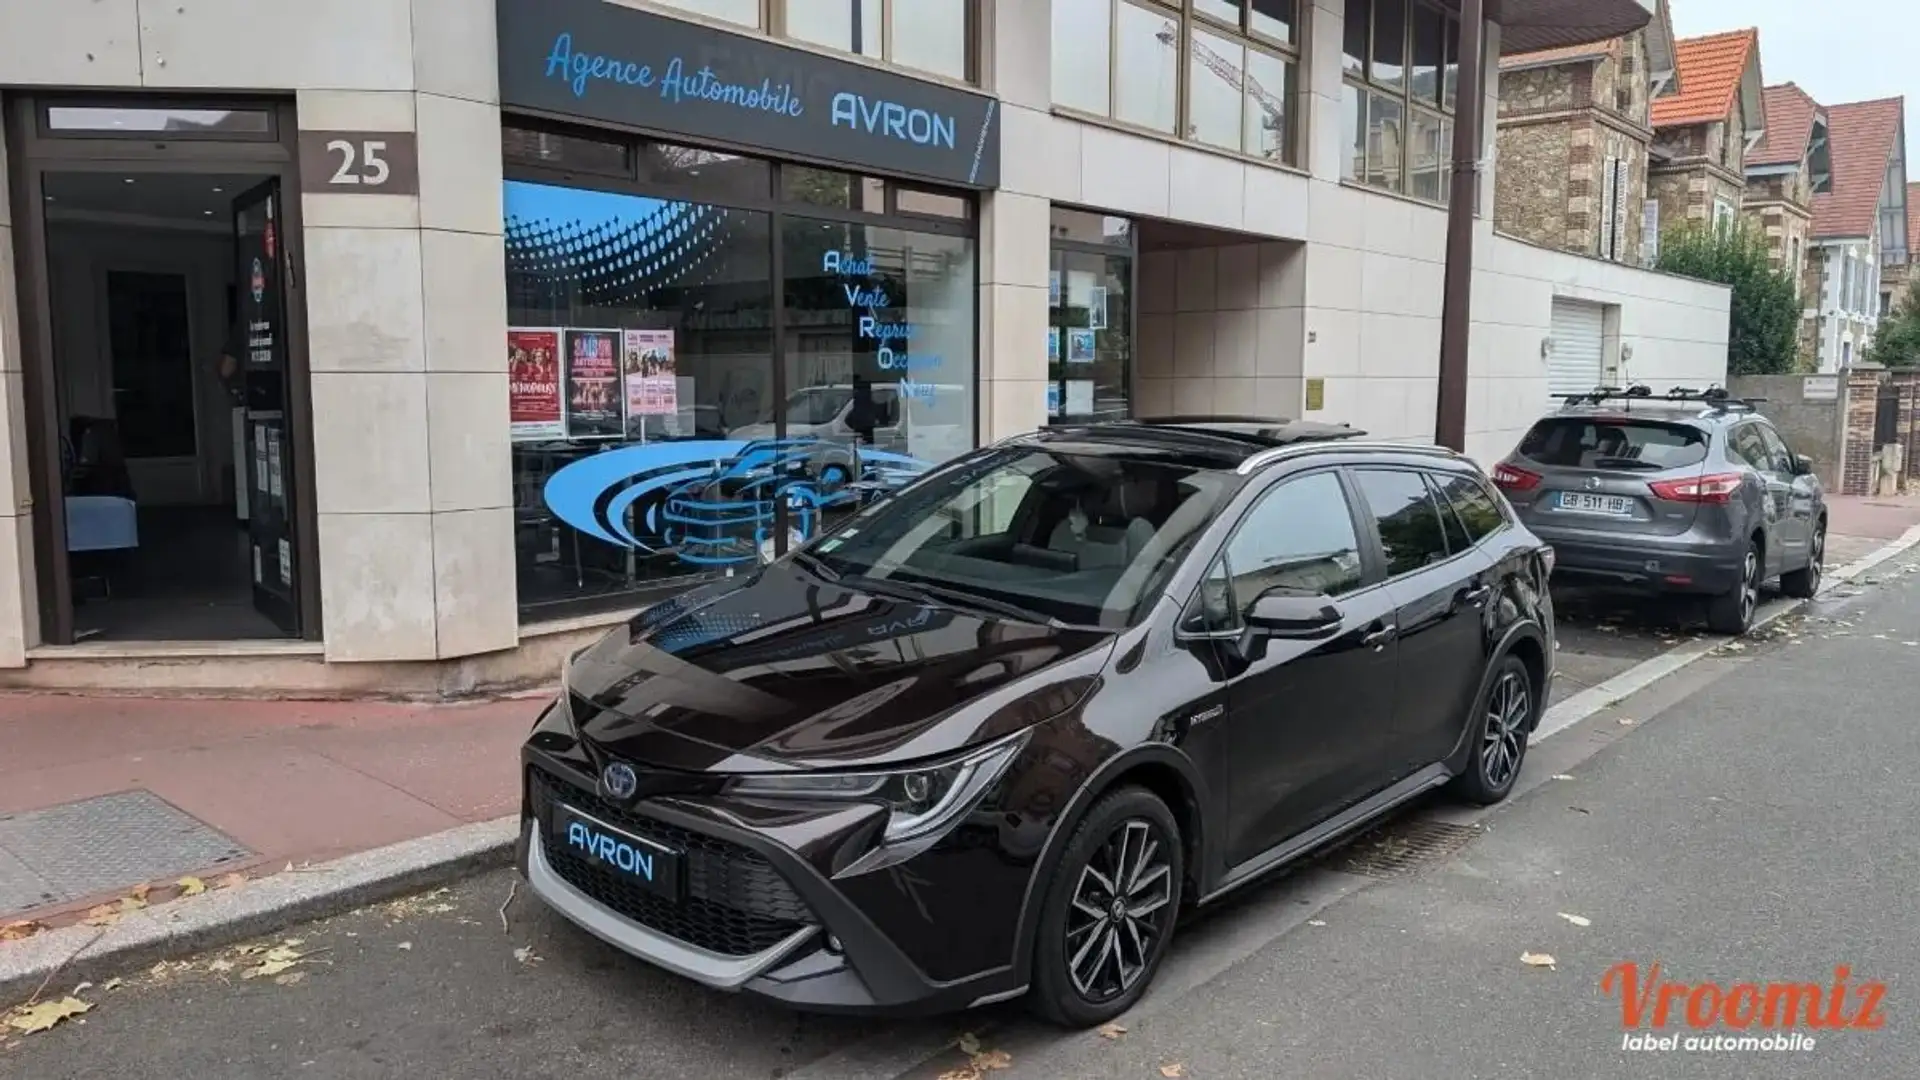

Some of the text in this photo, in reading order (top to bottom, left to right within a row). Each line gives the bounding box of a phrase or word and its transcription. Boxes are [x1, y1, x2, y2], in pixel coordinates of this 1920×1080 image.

[546, 32, 656, 97] Agence
[660, 57, 804, 117] Automobile
[832, 92, 955, 150] AVRON
[327, 140, 390, 185] 25
[823, 250, 875, 276] Achat
[843, 283, 889, 307] Vente
[569, 822, 653, 882] AVRON
